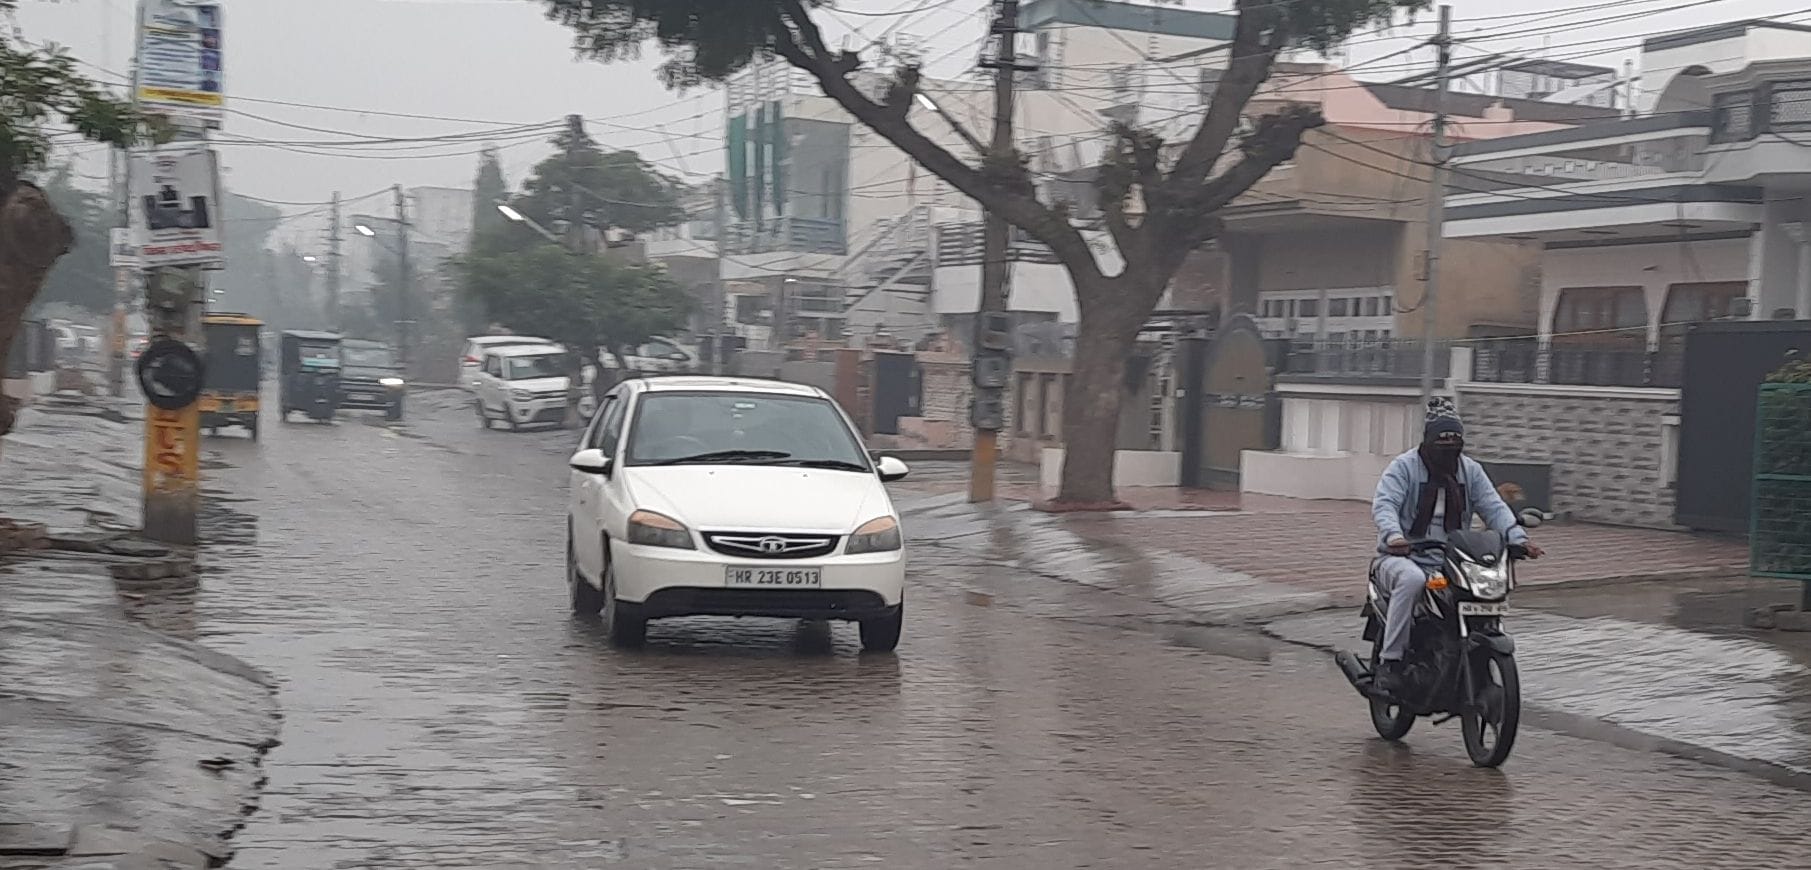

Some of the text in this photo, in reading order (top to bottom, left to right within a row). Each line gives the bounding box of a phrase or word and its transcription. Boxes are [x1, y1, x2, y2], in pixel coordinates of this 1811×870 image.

[735, 570, 752, 584] HR
[757, 570, 783, 584] 23E
[786, 571, 819, 585] 0513
